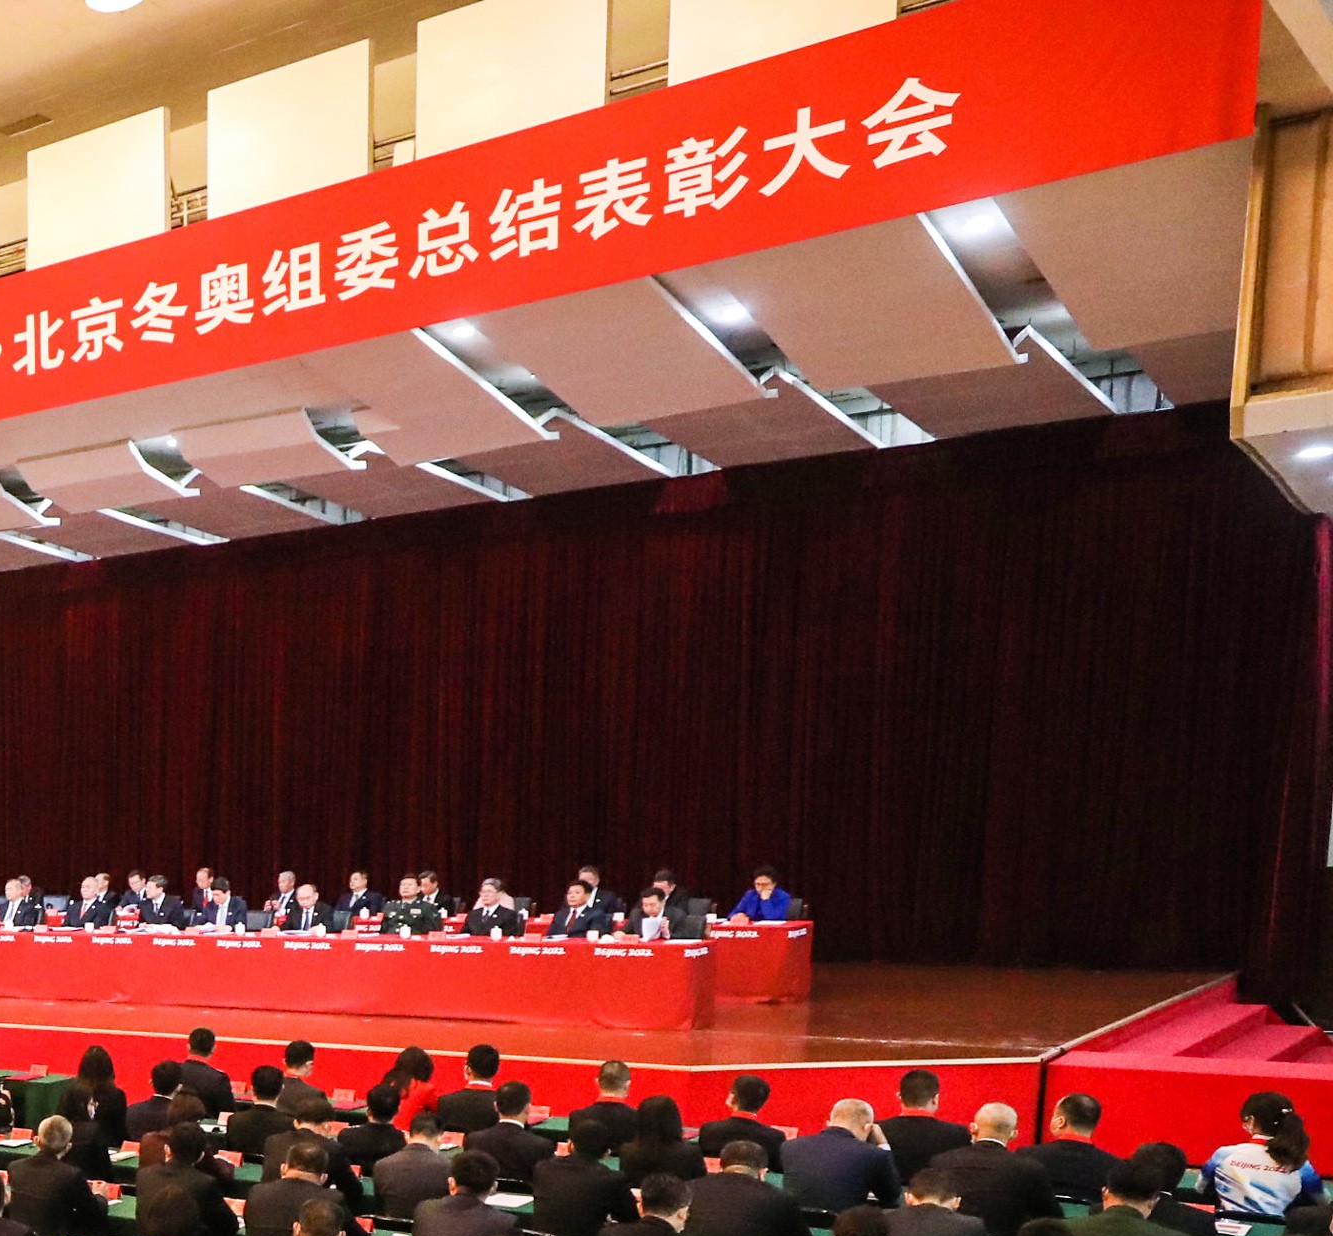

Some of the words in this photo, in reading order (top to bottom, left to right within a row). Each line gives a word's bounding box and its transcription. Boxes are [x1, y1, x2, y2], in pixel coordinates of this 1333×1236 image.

[709, 930, 734, 939] EIJING
[217, 940, 241, 949] BEIJING
[284, 941, 309, 951] BEIJING
[311, 942, 331, 950] 2022
[355, 943, 382, 952] BEIJING
[430, 944, 459, 954] BEIJING
[460, 945, 483, 953] 2022
[510, 946, 540, 956] BEIJING
[542, 947, 566, 955] 2022
[594, 947, 626, 958] BEIJING
[627, 948, 653, 957] 2022
[1229, 1159, 1261, 1171] BEIJING
